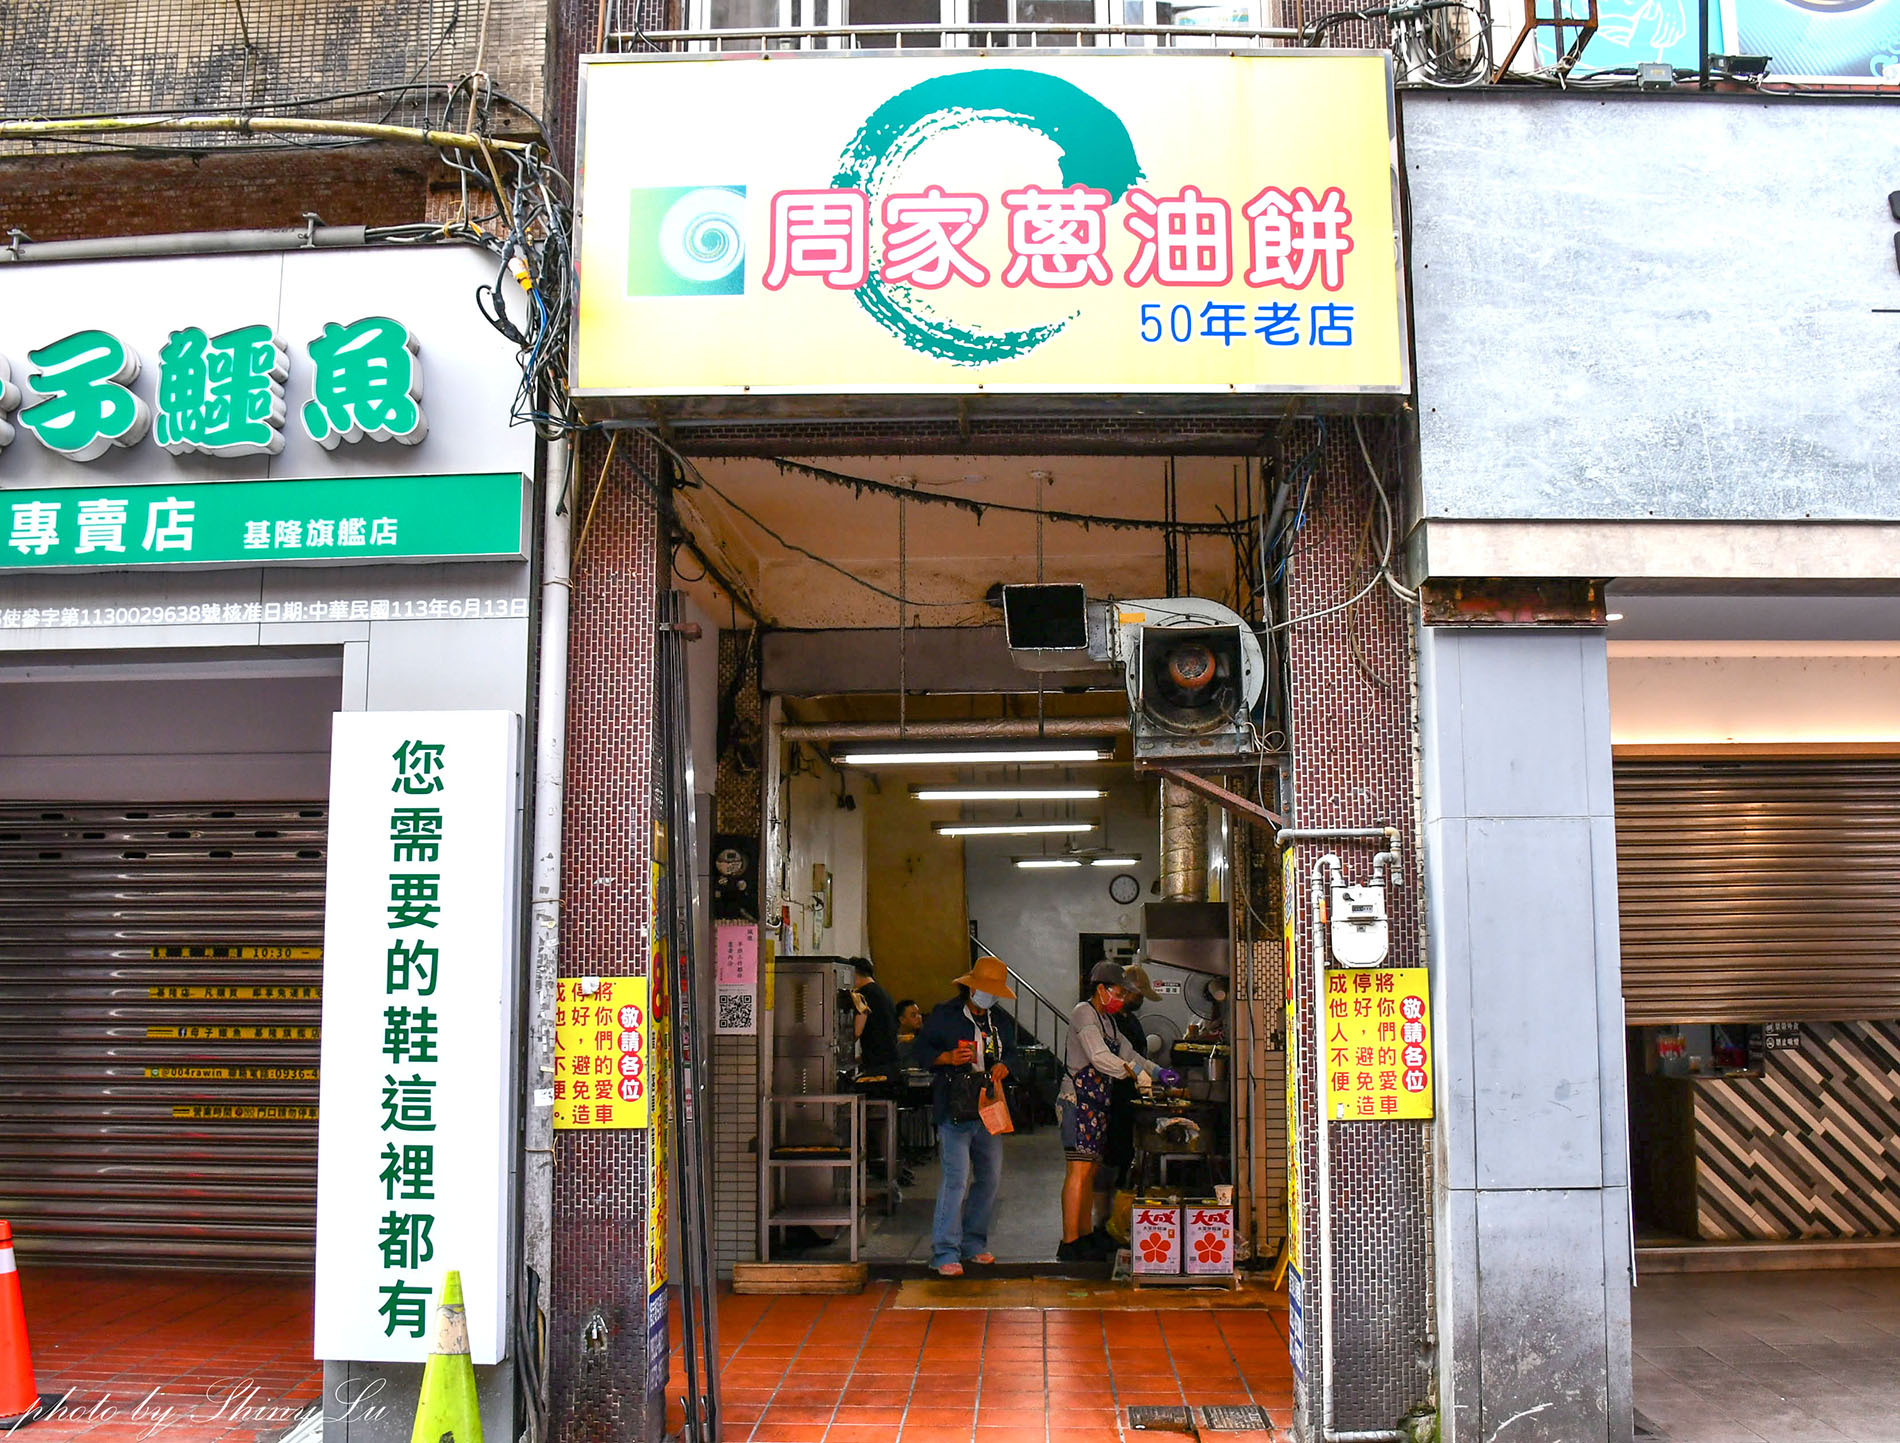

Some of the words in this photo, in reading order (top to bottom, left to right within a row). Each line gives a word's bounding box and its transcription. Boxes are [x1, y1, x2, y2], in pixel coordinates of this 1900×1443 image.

[763, 185, 1353, 291] 周家蔥油餅
[1141, 300, 1353, 347] 50年老店
[0, 316, 425, 462] 子鱷魚
[8, 497, 196, 556] 專賣店
[243, 516, 399, 550] 基隆旗艦店
[378, 739, 446, 1339] 您需要的鞋這裡都有
[594, 981, 614, 1123] 將你們的愛車
[620, 1006, 641, 1100] 敬請各位
[1375, 973, 1399, 1115] 將你們的愛車
[1402, 997, 1425, 1091] 敬請各位
